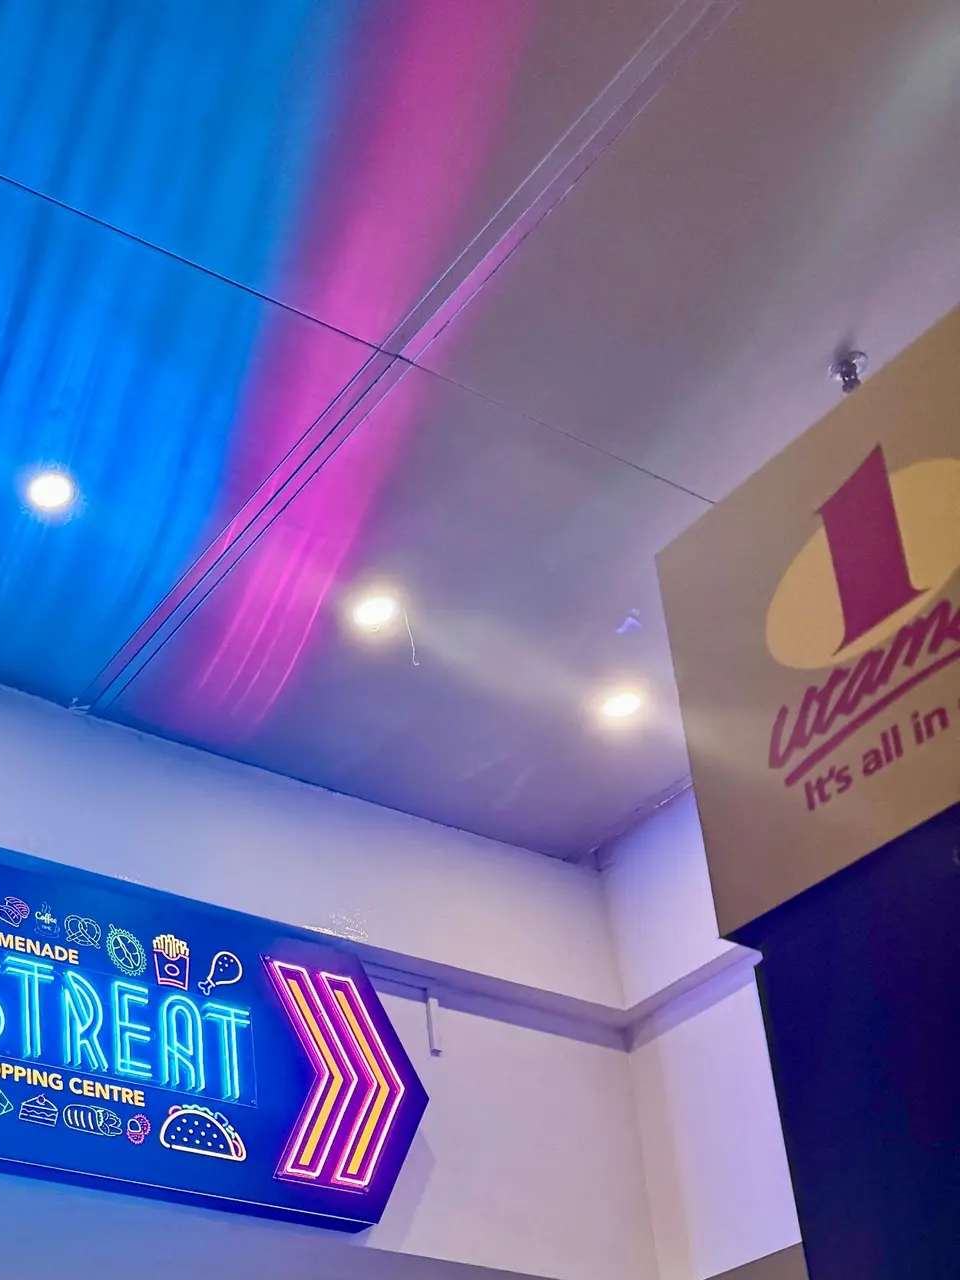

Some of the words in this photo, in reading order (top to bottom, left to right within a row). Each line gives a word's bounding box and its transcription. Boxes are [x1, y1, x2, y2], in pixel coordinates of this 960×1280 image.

[804, 765, 853, 812] It's
[862, 724, 904, 777] all
[911, 706, 950, 745] in
[35, 911, 57, 924] Coffee
[69, 1077, 146, 1107] CENTRE
